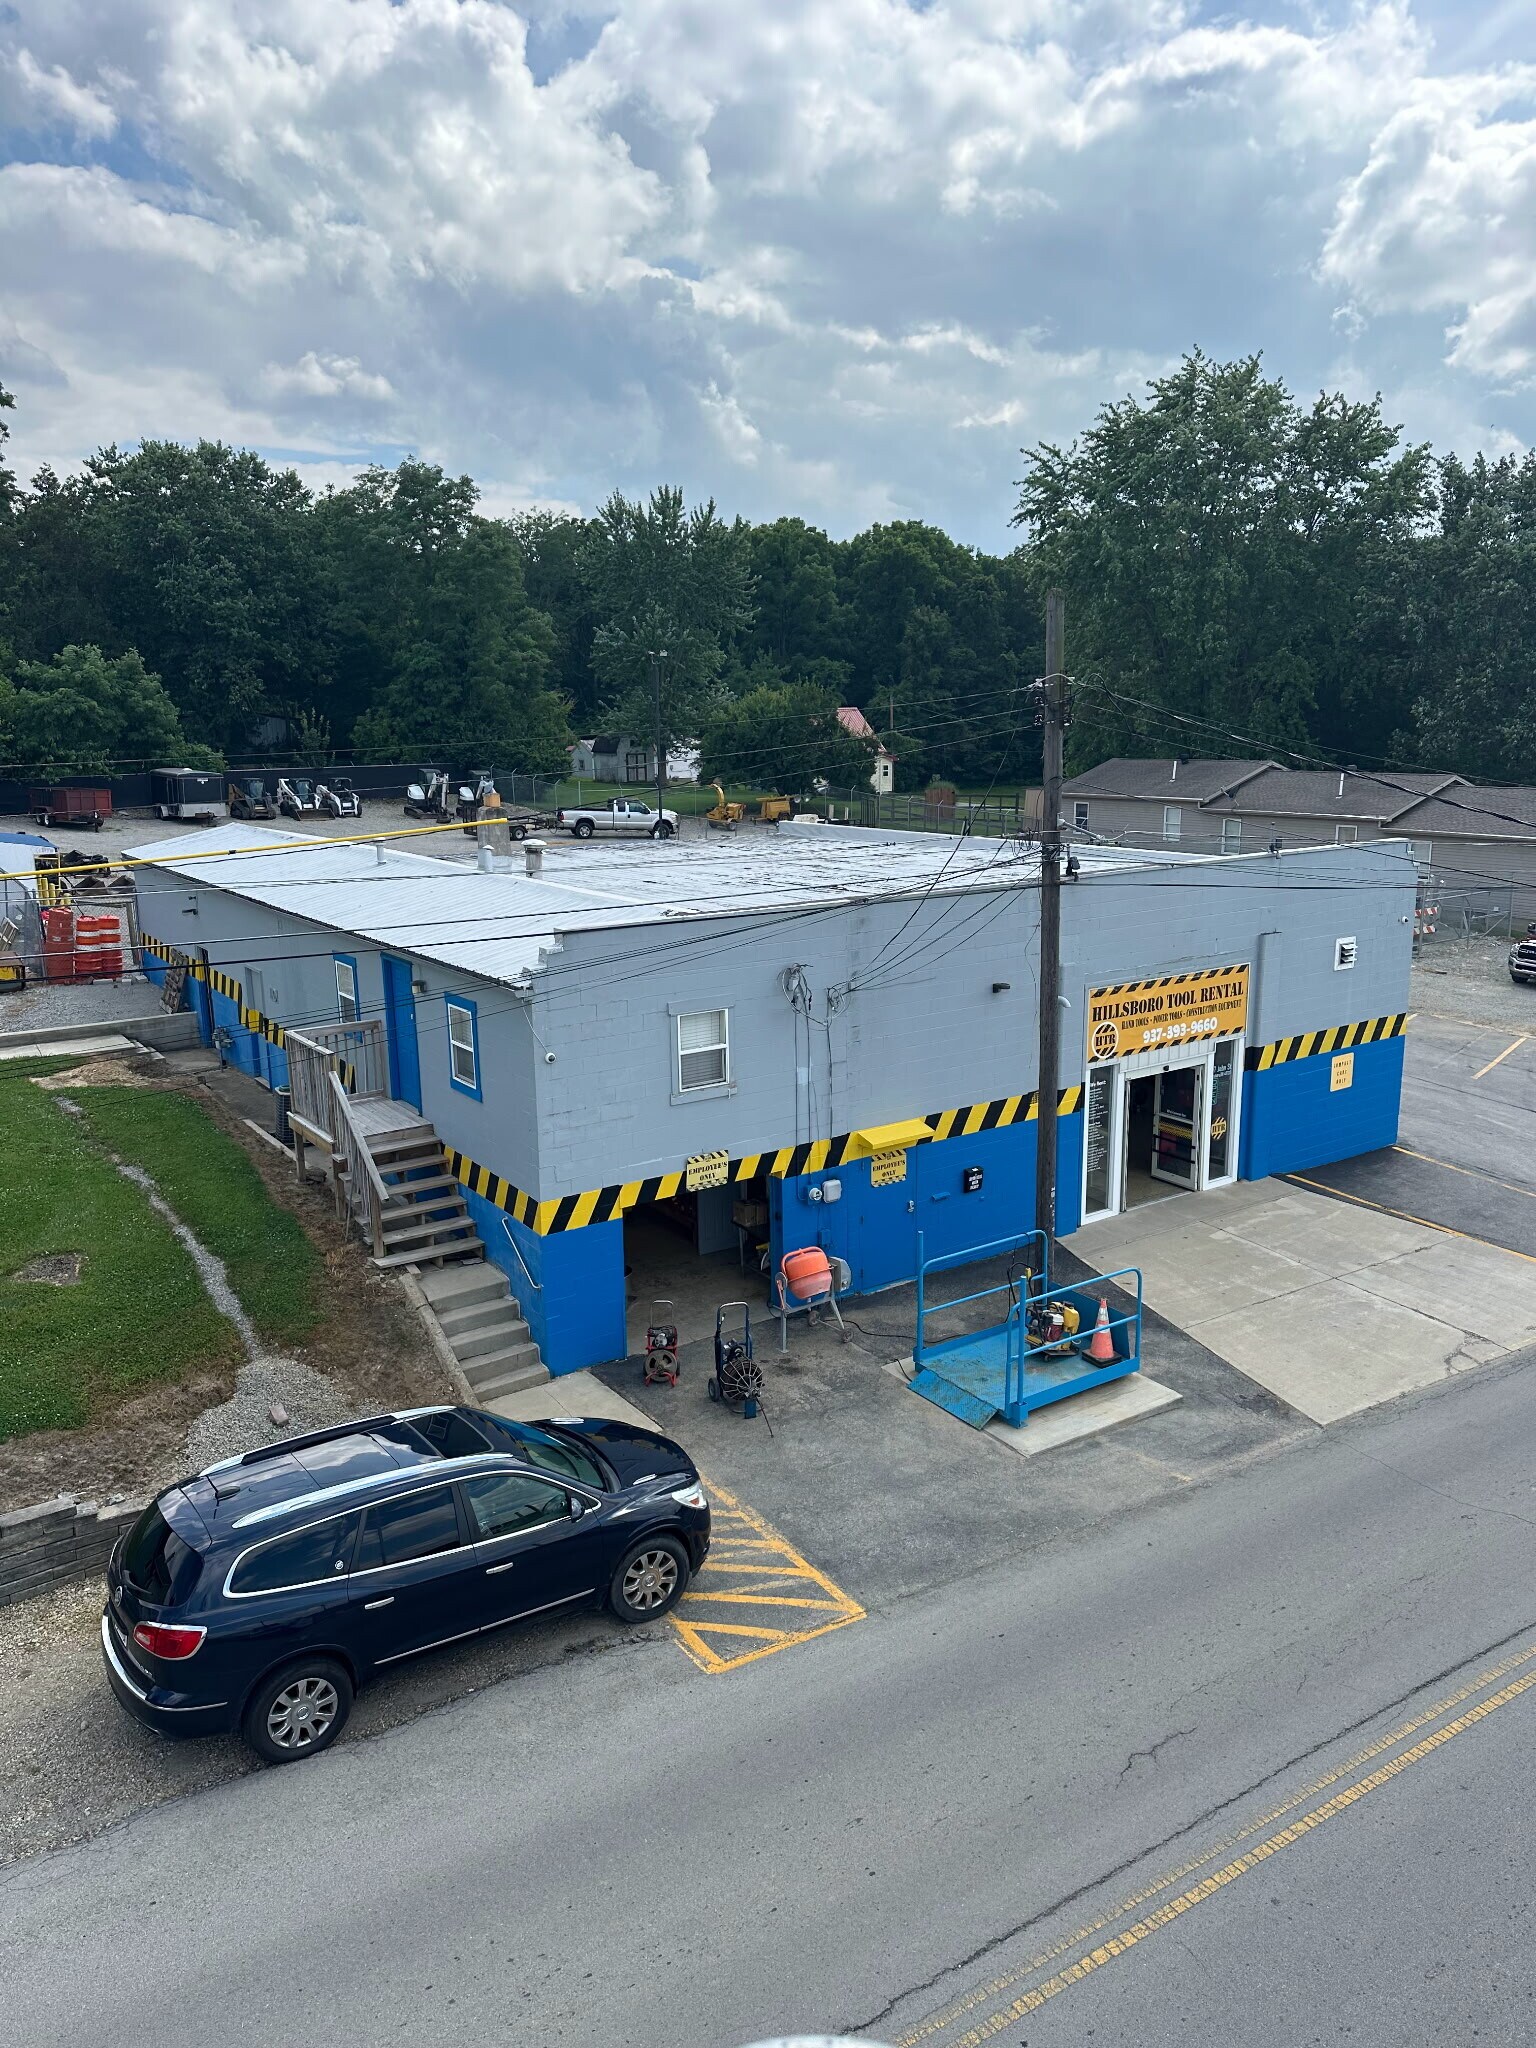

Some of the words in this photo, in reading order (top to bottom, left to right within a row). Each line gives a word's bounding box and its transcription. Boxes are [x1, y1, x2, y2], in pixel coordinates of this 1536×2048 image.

[1092, 996, 1164, 1022] HILLSBORO
[1167, 990, 1197, 1009] TOOL
[1200, 981, 1243, 1003] RENTAL
[1121, 1020, 1135, 1030] HAND
[1136, 1016, 1149, 1028] TOOLS
[1153, 1014, 1169, 1025] POWER
[1169, 1011, 1183, 1020] TOOLS
[1186, 1003, 1217, 1017] CONSTRUCTION
[1143, 1017, 1218, 1044] 937-393-9660
[1095, 1034, 1116, 1047] HTR
[688, 1161, 728, 1175] EMPLOYEE'S
[872, 1160, 906, 1172] EMPLOYEE'S
[699, 1172, 716, 1181] ONLY
[881, 1169, 896, 1178] ONLY
